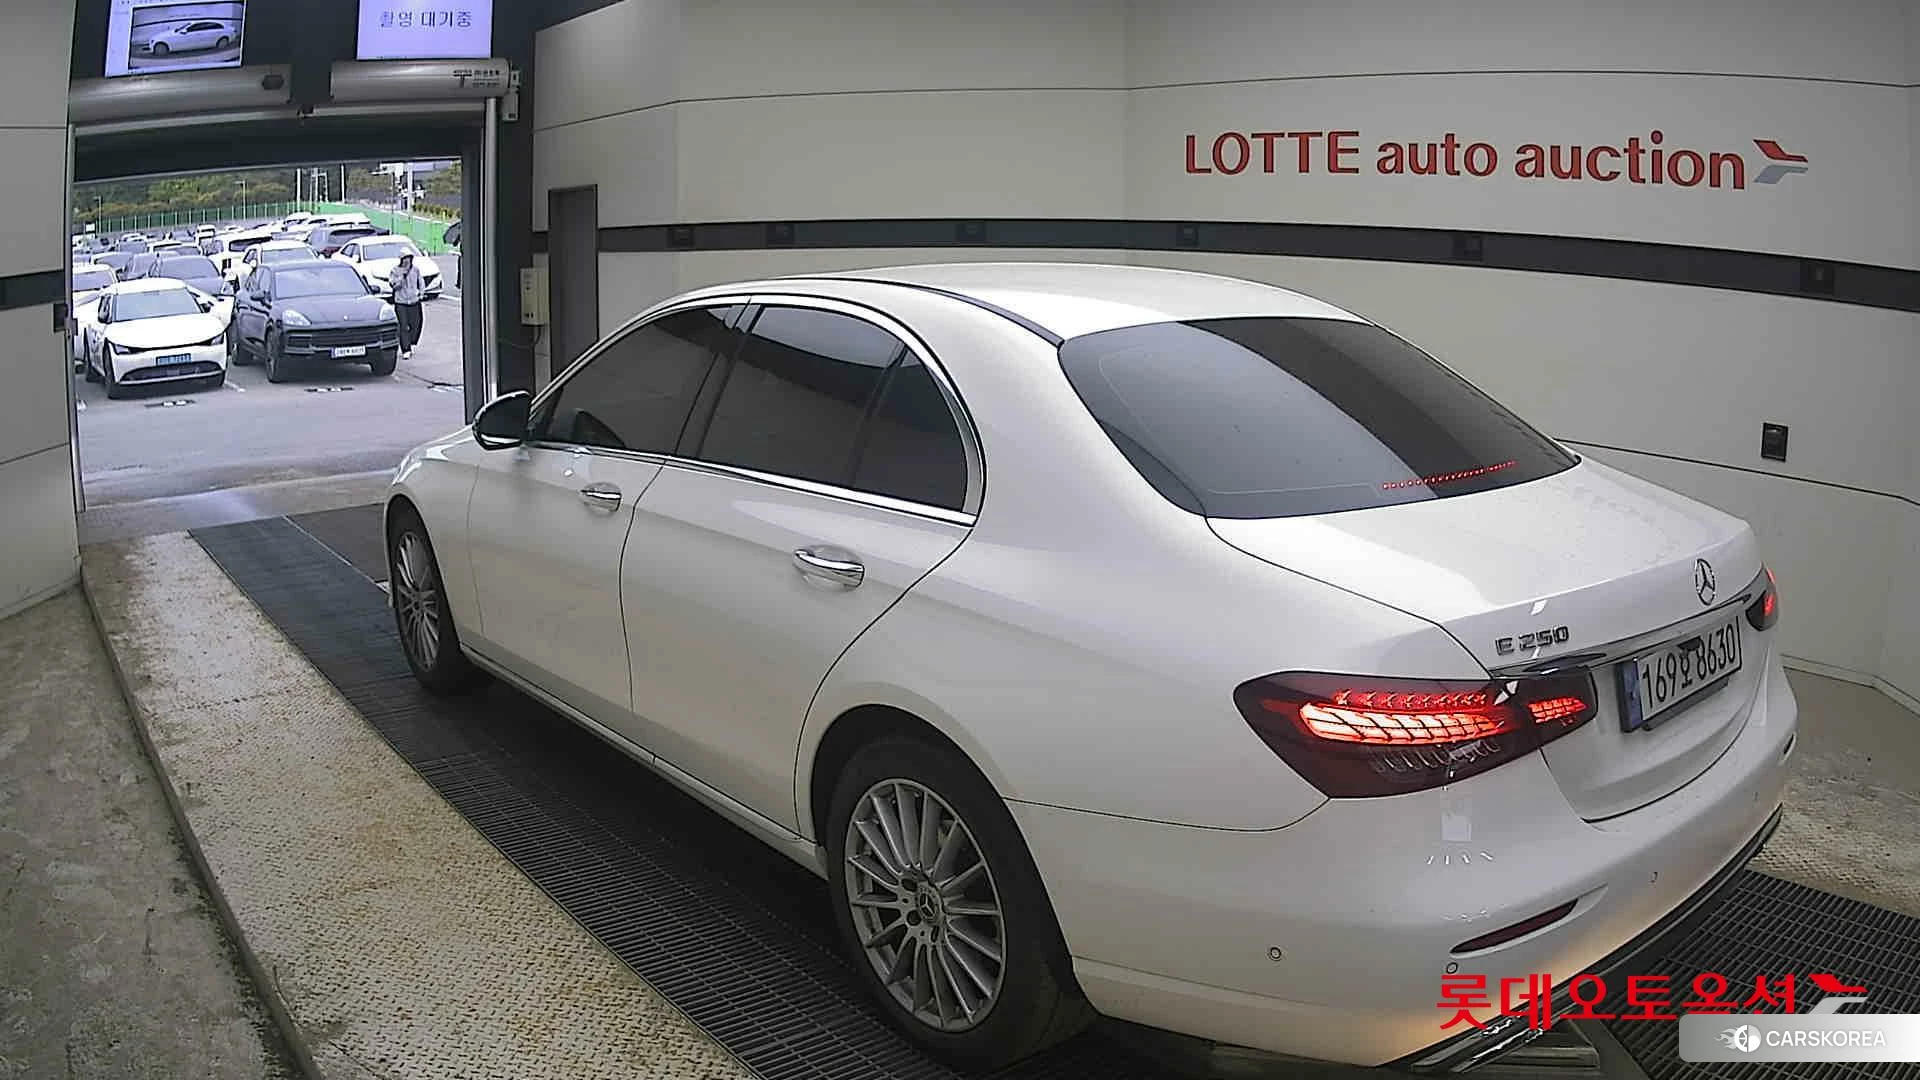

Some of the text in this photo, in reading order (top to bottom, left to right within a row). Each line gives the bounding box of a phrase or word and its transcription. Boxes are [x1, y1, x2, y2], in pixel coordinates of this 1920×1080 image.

[380, 11, 472, 28] 영 대기중
[1185, 129, 1746, 190] LOTTE auto auction
[1495, 626, 1569, 656] E 250
[1696, 623, 1736, 681] 8630
